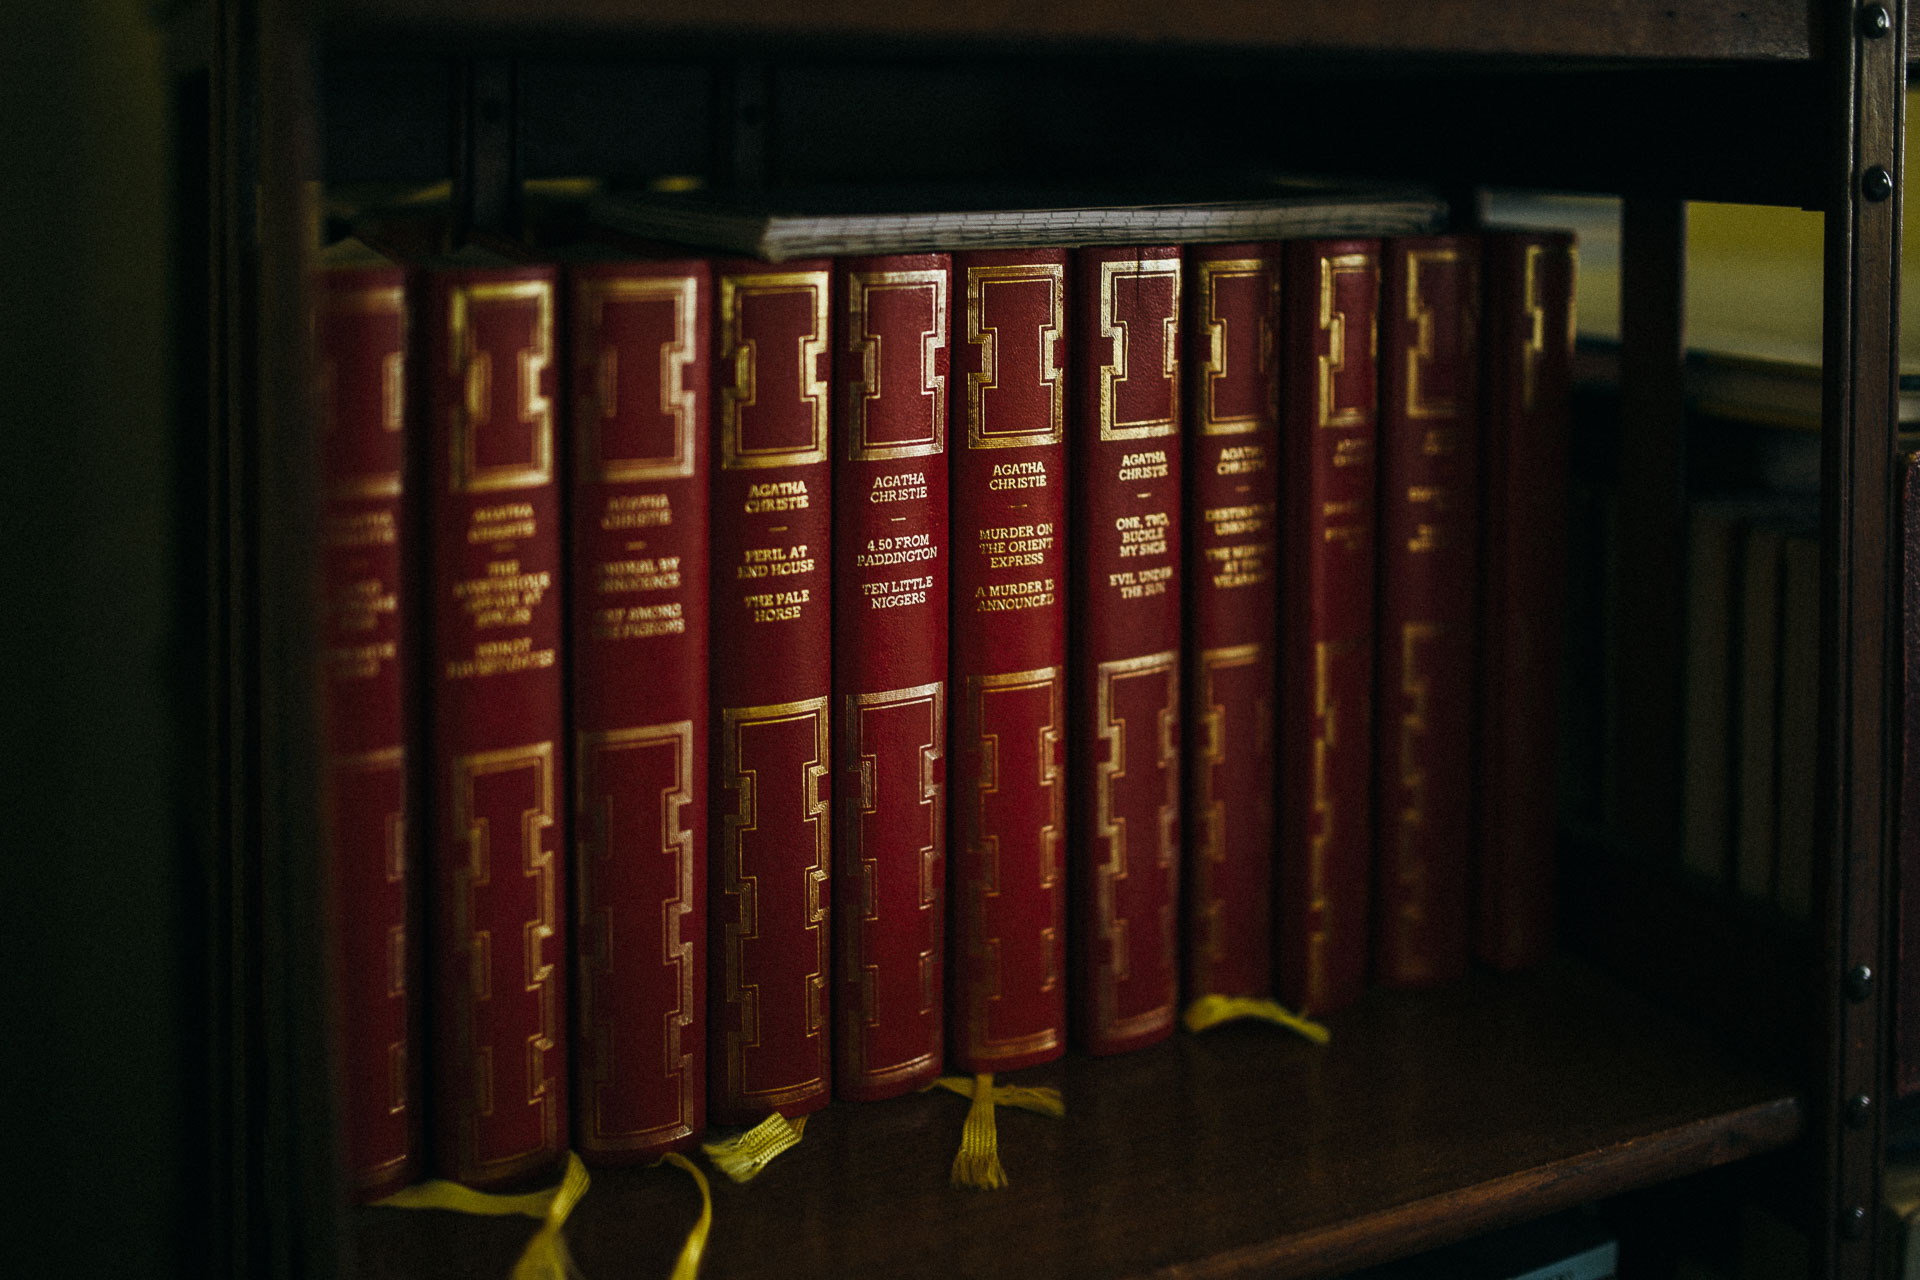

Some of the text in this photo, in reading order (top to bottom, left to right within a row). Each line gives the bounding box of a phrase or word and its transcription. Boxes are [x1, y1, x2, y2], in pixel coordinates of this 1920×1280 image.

[1121, 450, 1167, 467] AGATHA
[992, 461, 1046, 477] AGATHA
[748, 480, 808, 498] AGATHA
[872, 472, 926, 489] AGATHA
[989, 474, 1047, 490] CHRISTIE
[870, 486, 928, 503] CHRISTIE
[744, 495, 809, 514] CHRISTIE
[979, 523, 1053, 540] MURDER ON
[867, 534, 930, 552] 4.50 FROM
[978, 537, 1054, 555] THE ORIENT
[1120, 544, 1137, 557] MY
[744, 545, 808, 563] PERIL AT
[856, 546, 938, 567] PADDINGTON
[990, 552, 1045, 568] EXPRESS
[771, 559, 815, 576] HOUSE
[862, 575, 933, 596] TEN LITTLE
[975, 578, 1055, 598] A MURDER IS
[1109, 571, 1137, 587] EVIL
[744, 589, 810, 608] THE PALE
[871, 591, 926, 610] NIGGERS
[1120, 585, 1143, 599] THE
[976, 592, 1055, 612] ANNOUNCED
[754, 605, 802, 623] HORSE
